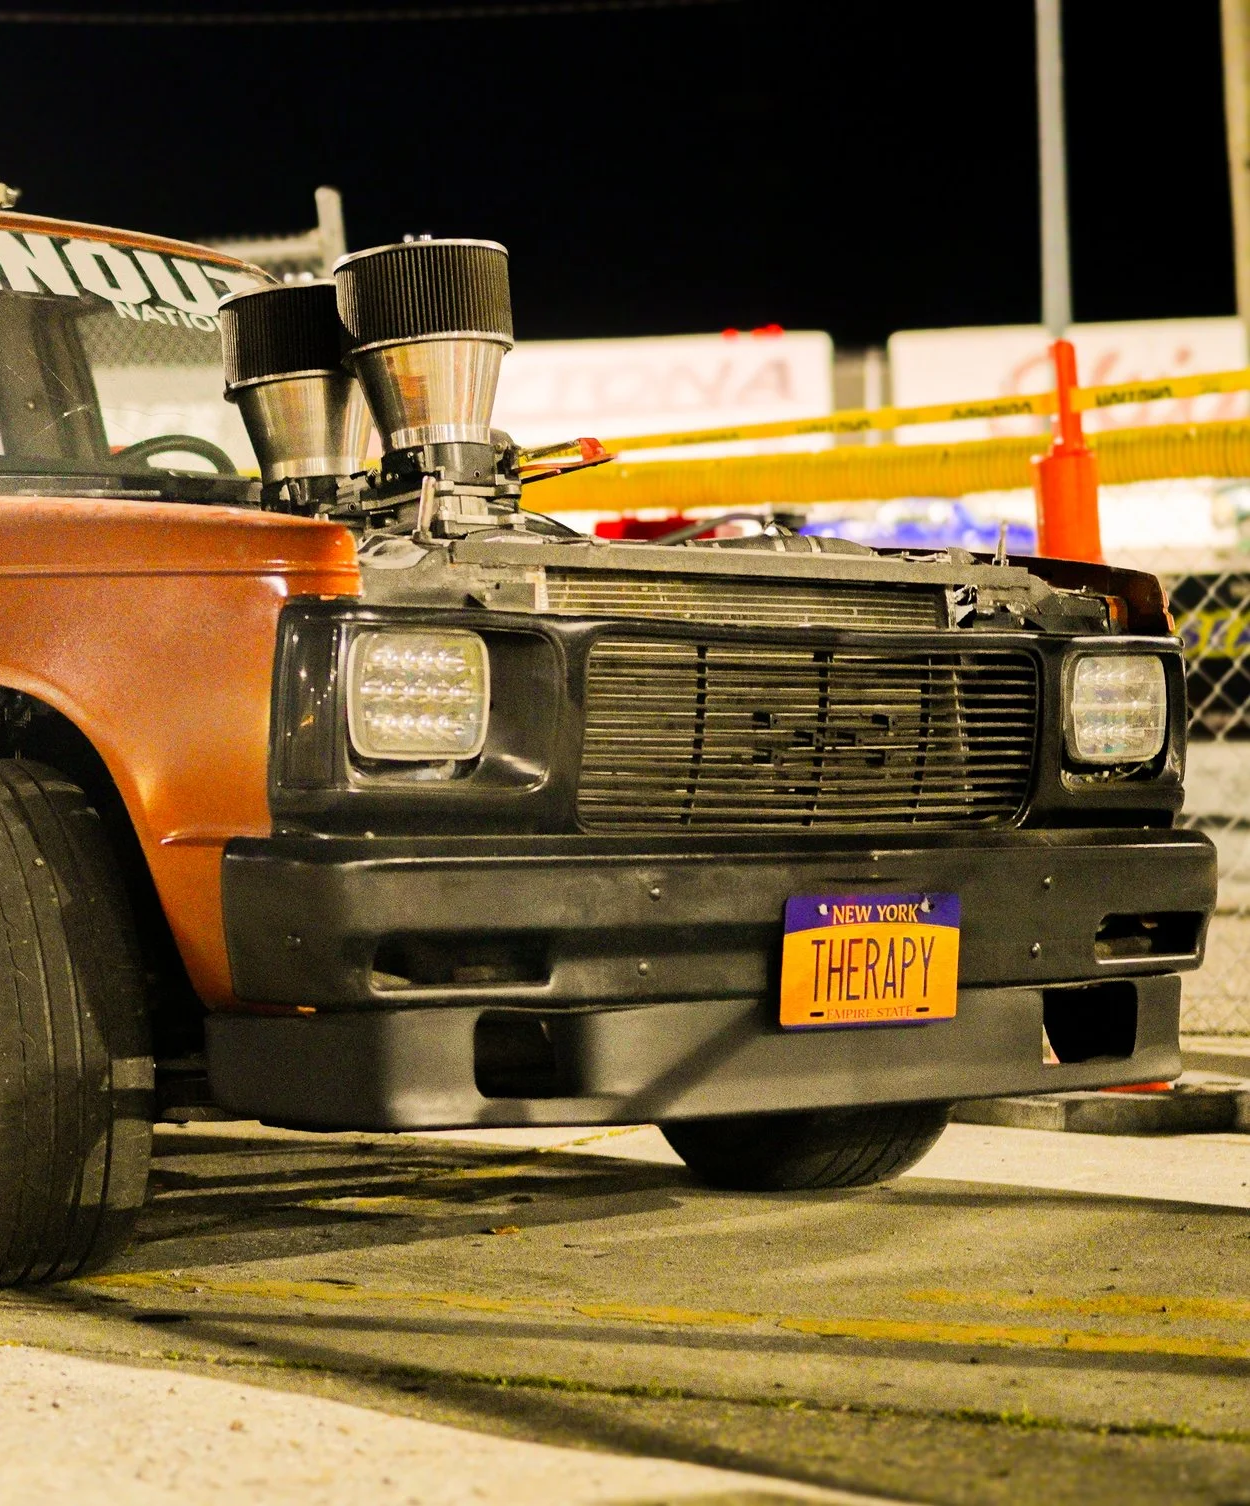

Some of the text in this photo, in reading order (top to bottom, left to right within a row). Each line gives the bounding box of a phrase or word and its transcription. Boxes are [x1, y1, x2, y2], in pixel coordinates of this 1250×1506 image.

[832, 903, 919, 924] NEW YORK
[811, 936, 936, 1002] THERAPY
[827, 1006, 912, 1020] EMPIRE STATE
